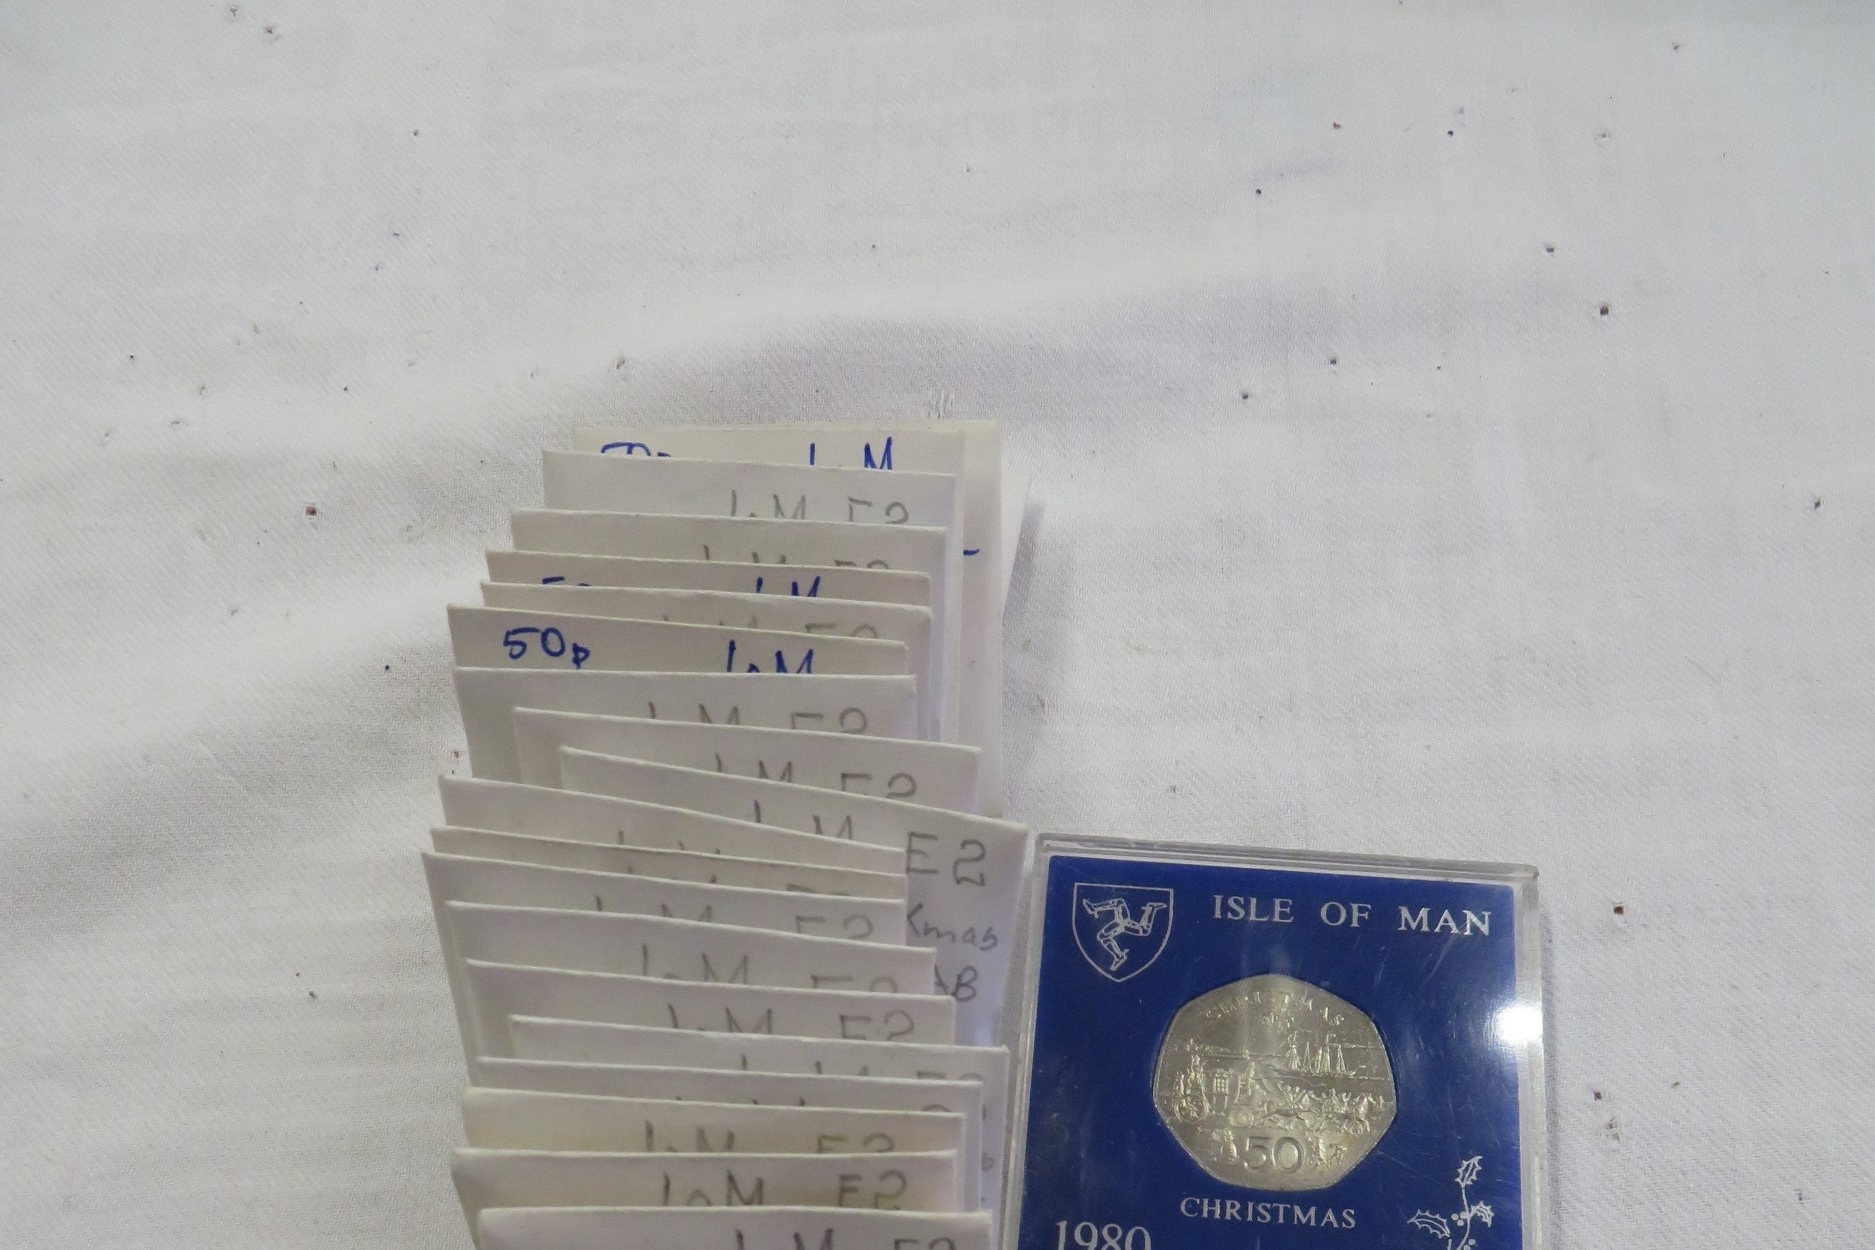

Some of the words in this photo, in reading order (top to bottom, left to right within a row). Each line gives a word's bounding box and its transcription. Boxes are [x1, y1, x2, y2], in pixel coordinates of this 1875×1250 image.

[503, 627, 591, 670] 50p
[904, 831, 986, 887] E2
[1212, 893, 1294, 925] ISLE
[1320, 901, 1372, 929] OF
[1399, 904, 1492, 938] MAN
[1244, 1135, 1305, 1173] 50
[1180, 1197, 1357, 1231] CHRISTMAS
